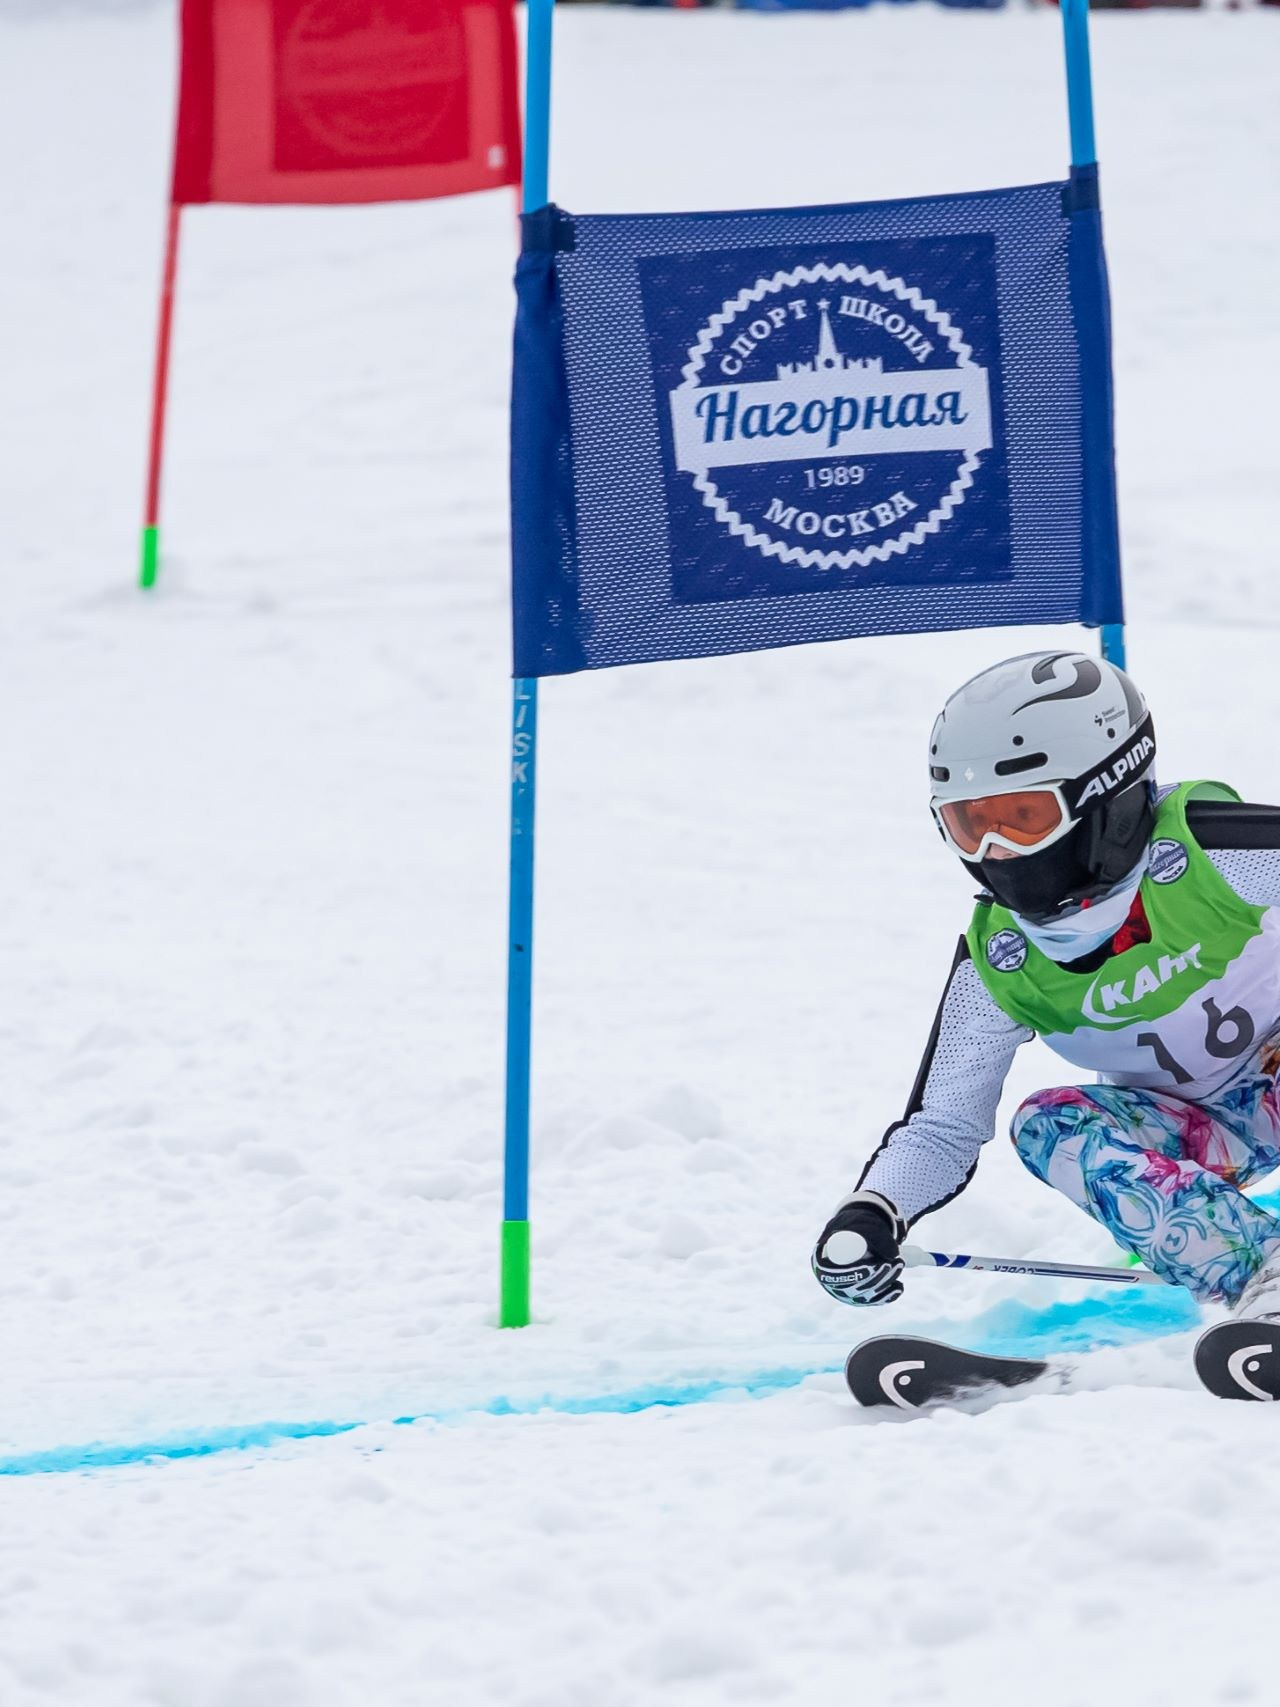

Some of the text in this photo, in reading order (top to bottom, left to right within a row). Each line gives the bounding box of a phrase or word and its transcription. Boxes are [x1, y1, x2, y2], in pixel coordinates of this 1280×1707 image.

[720, 296, 935, 376] СПОРТ ШКОЛА
[696, 390, 969, 449] Нагорная
[804, 466, 865, 489] 1989
[763, 491, 918, 538] МОСКВА
[511, 678, 531, 795] LISK
[1075, 735, 1155, 809] ALPINA
[1137, 997, 1255, 1085] 16
[821, 1271, 863, 1283] reusch
